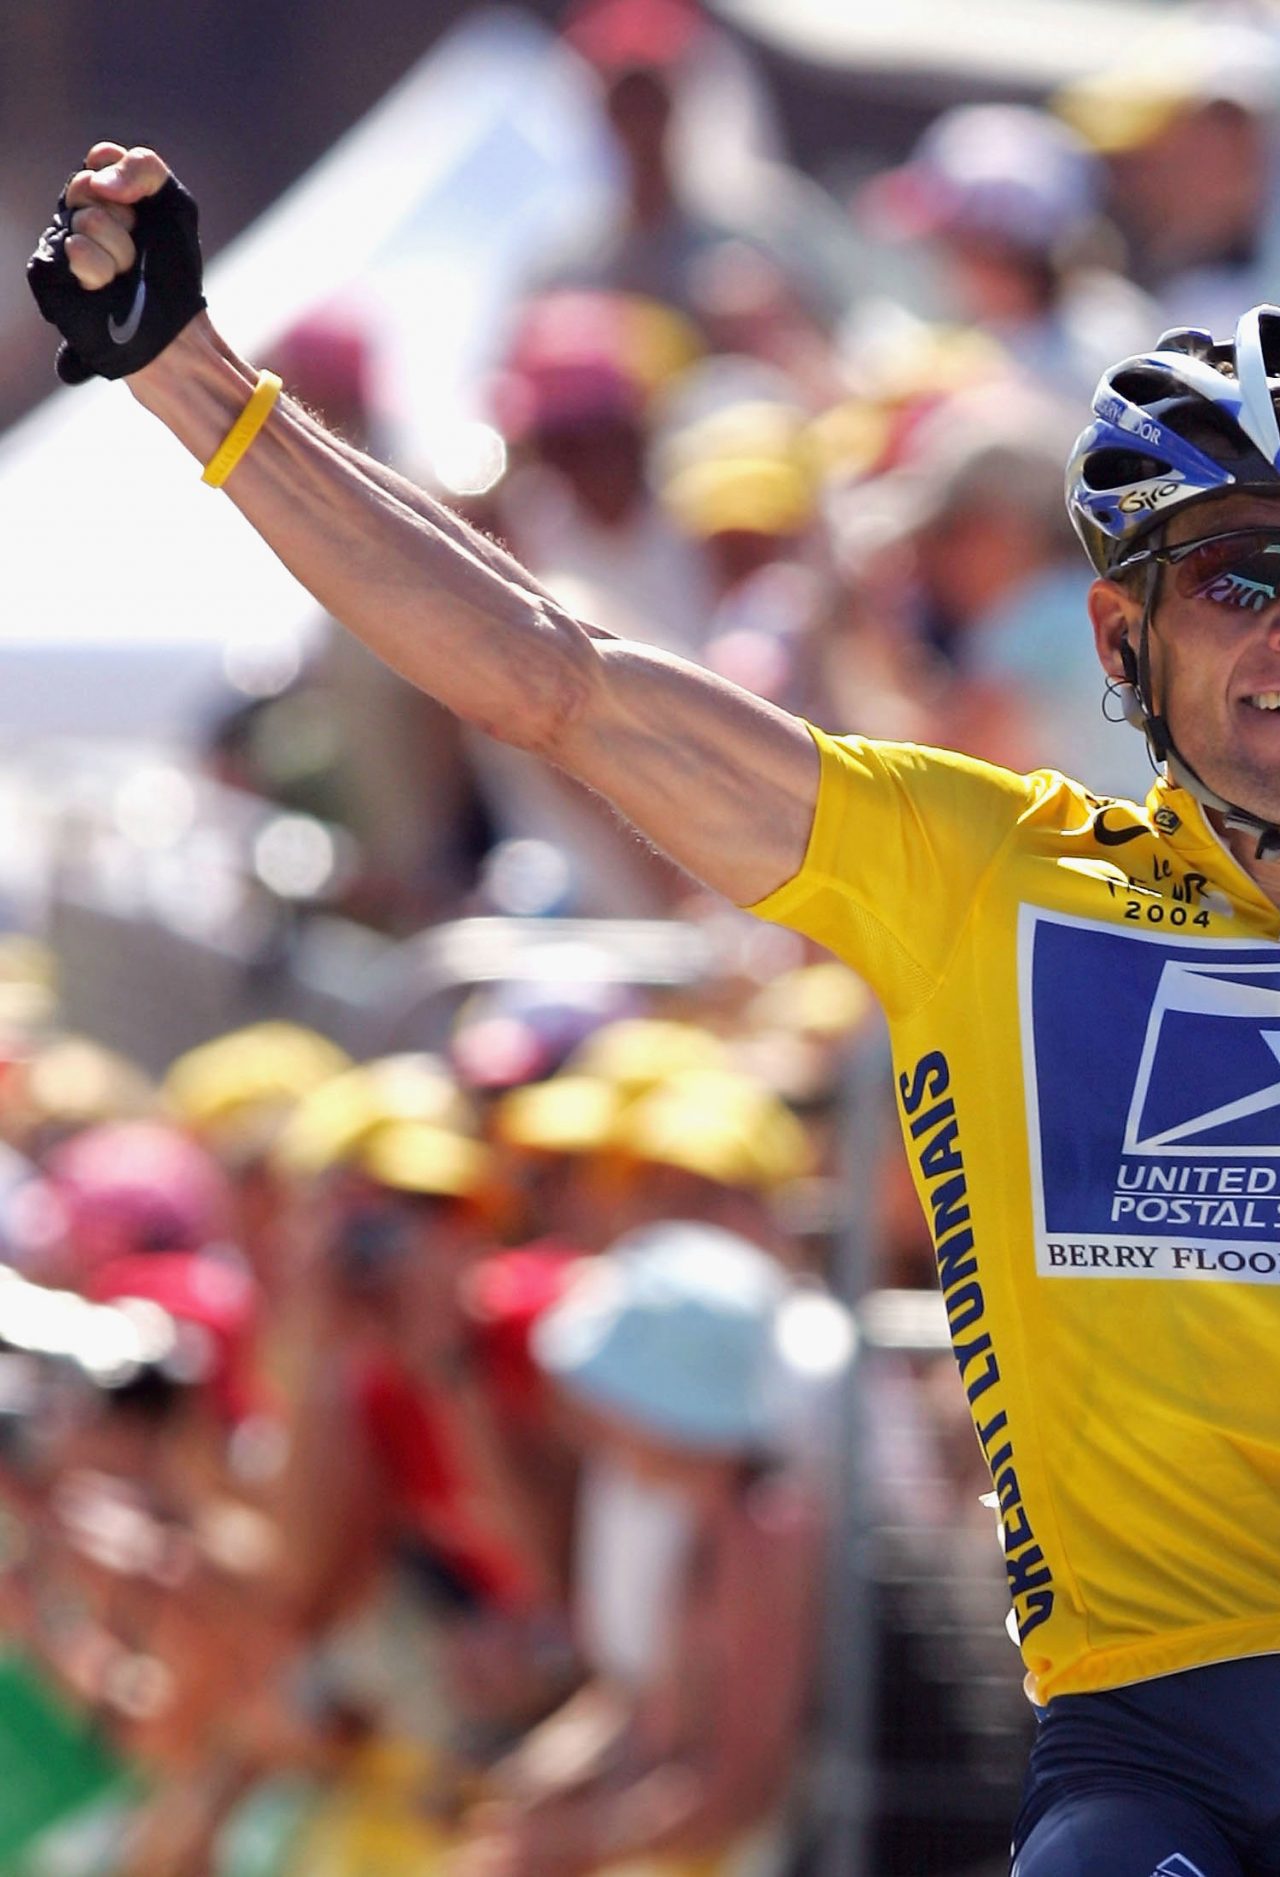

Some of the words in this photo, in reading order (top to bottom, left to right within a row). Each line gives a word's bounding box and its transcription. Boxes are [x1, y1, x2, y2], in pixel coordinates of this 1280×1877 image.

[1118, 482, 1179, 514] Giro
[1124, 900, 1210, 928] 2004
[1116, 1164, 1279, 1194] UNITED
[900, 1050, 1000, 1402] LYONNAIS
[1111, 1197, 1265, 1229] POSTAL
[1047, 1243, 1158, 1270] BERRY
[974, 1409, 1054, 1647] CREDIT
